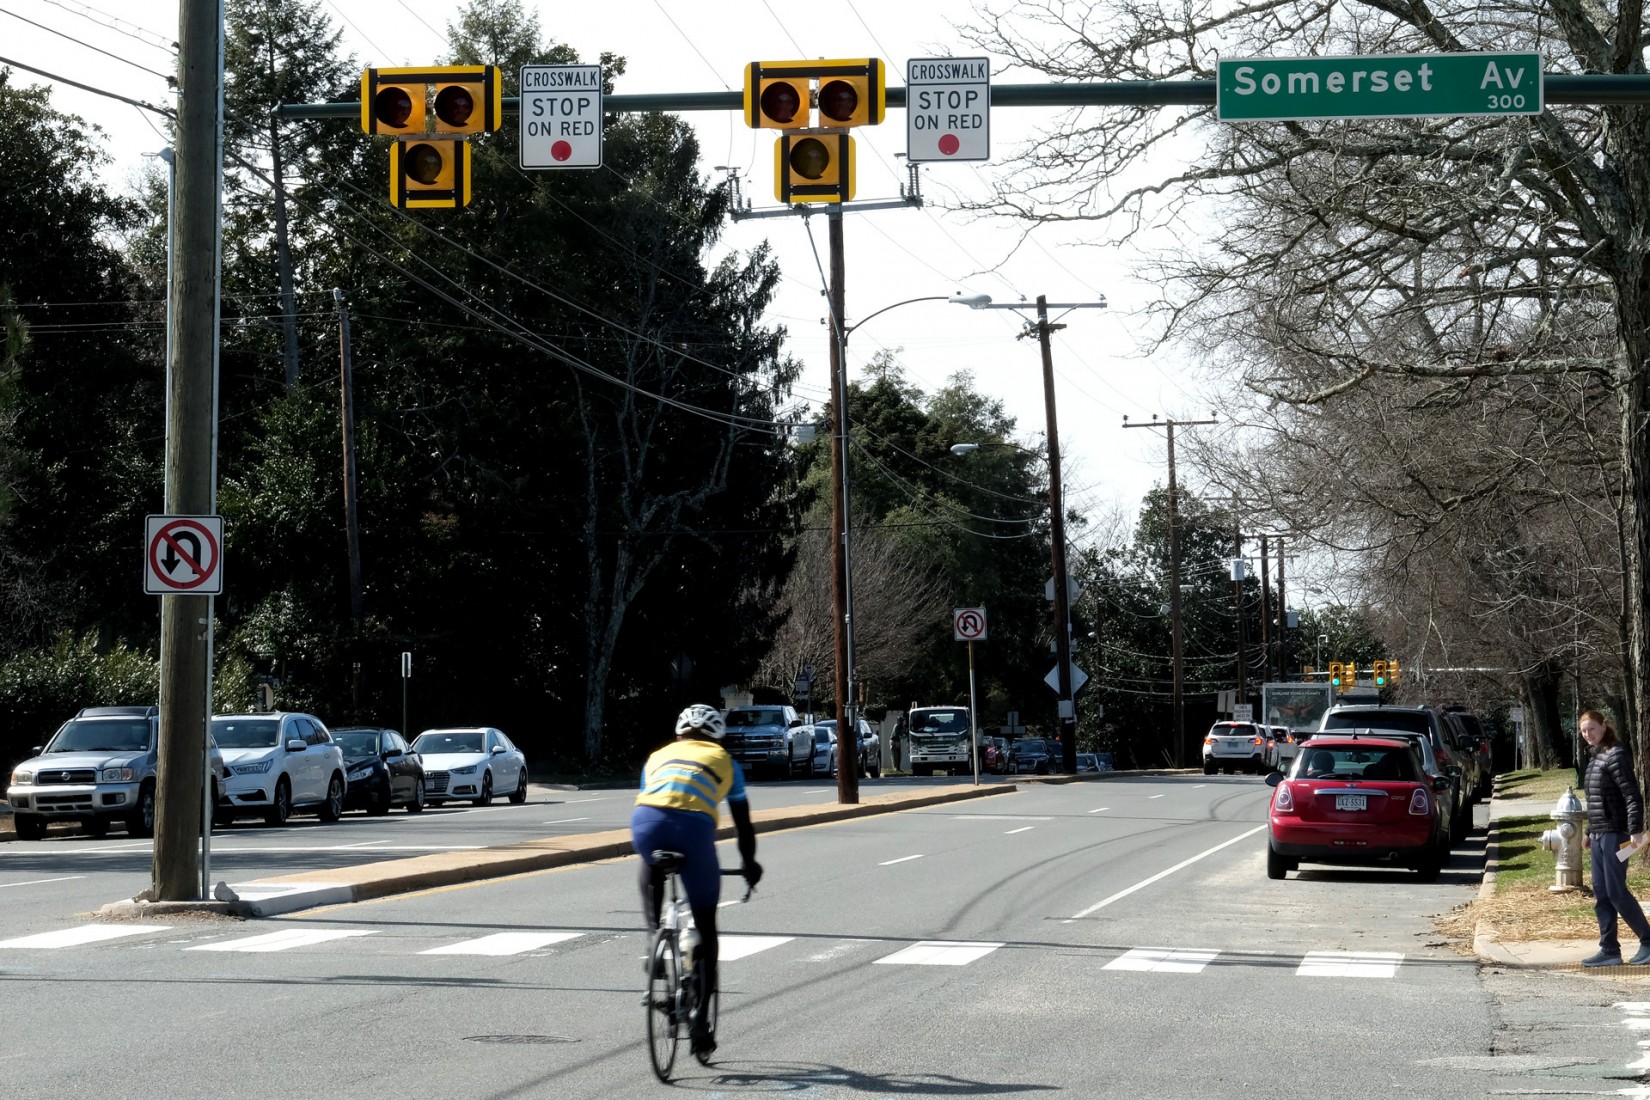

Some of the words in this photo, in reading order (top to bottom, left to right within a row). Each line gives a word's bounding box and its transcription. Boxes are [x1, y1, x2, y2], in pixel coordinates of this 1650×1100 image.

[526, 71, 597, 87] CROSSWALK
[911, 63, 985, 80] CROSSWALK
[1234, 63, 1433, 95] Somerset
[1480, 61, 1525, 90] Av
[532, 97, 590, 117] STOP
[918, 90, 978, 110] STOP
[1487, 94, 1526, 109] 300
[528, 121, 552, 137] ON
[560, 120, 594, 137] RED
[914, 114, 939, 131] ON
[948, 113, 982, 130] RED
